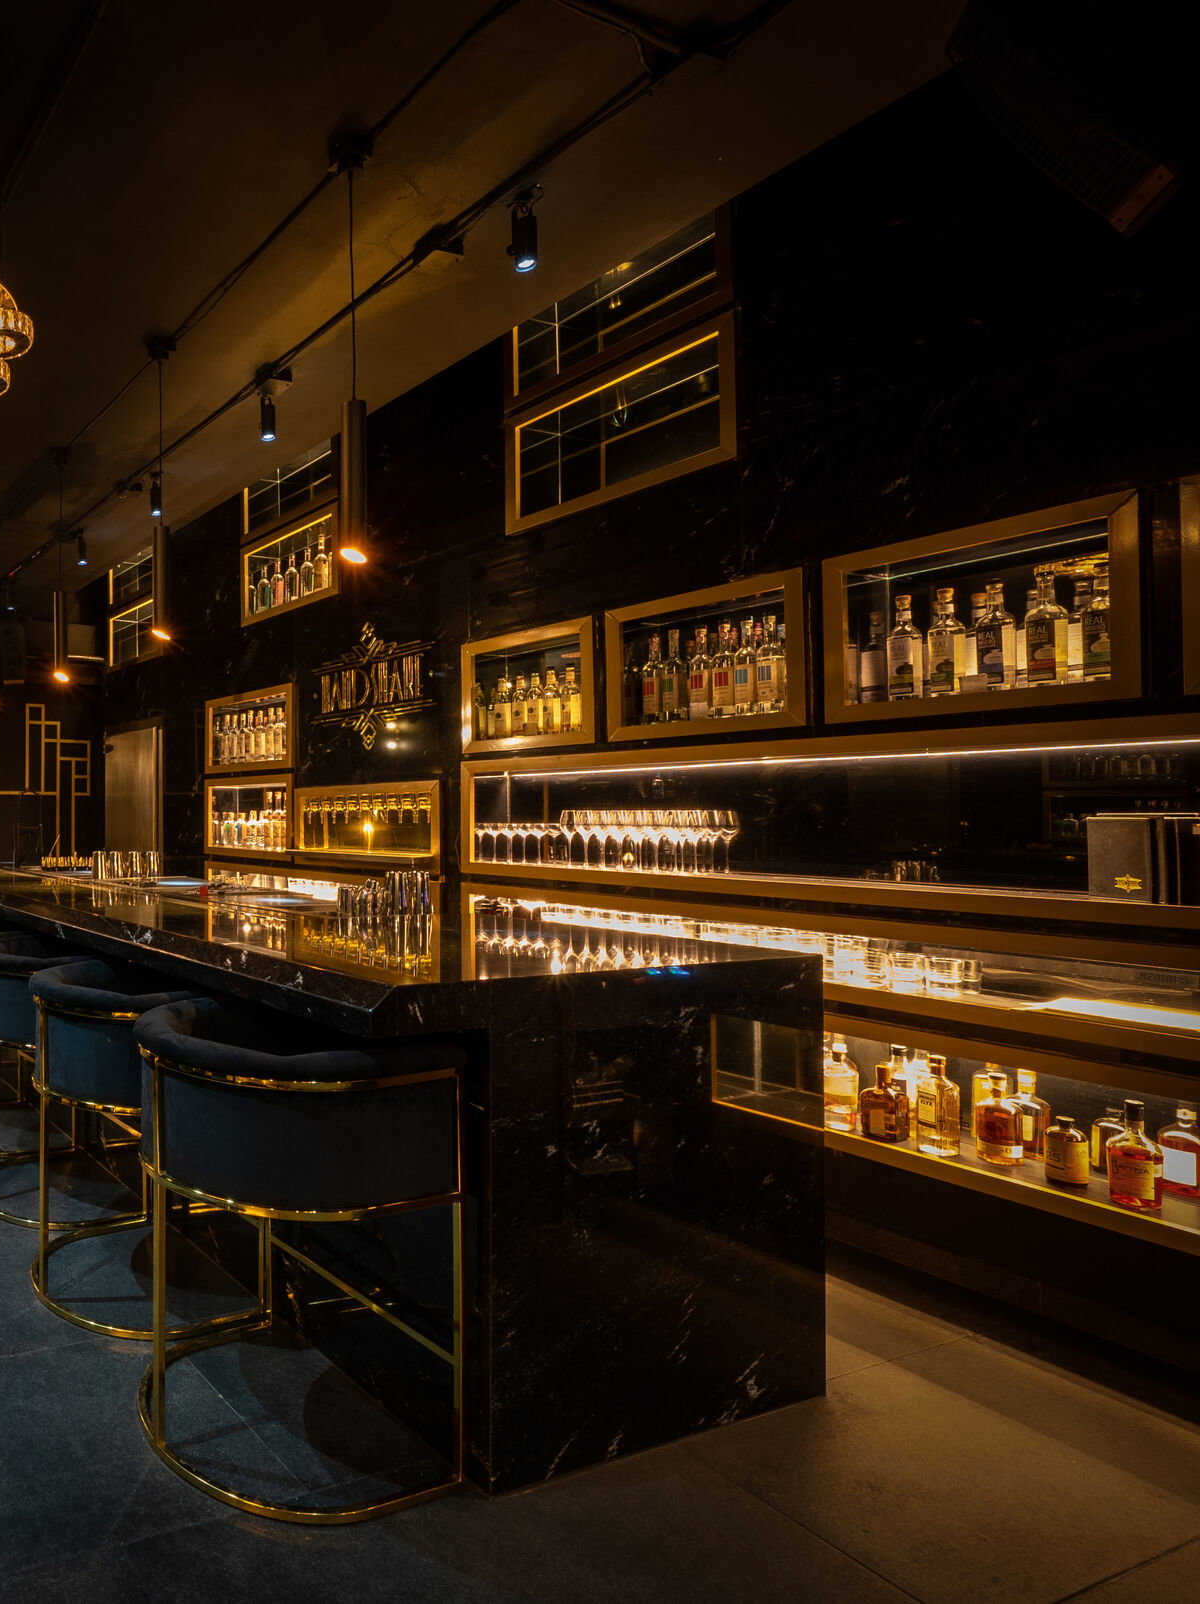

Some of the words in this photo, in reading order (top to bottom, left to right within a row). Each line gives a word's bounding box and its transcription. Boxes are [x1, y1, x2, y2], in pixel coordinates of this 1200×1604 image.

[1084, 616, 1106, 626] REAL
[1028, 625, 1048, 636] REAL
[978, 631, 996, 642] REAL
